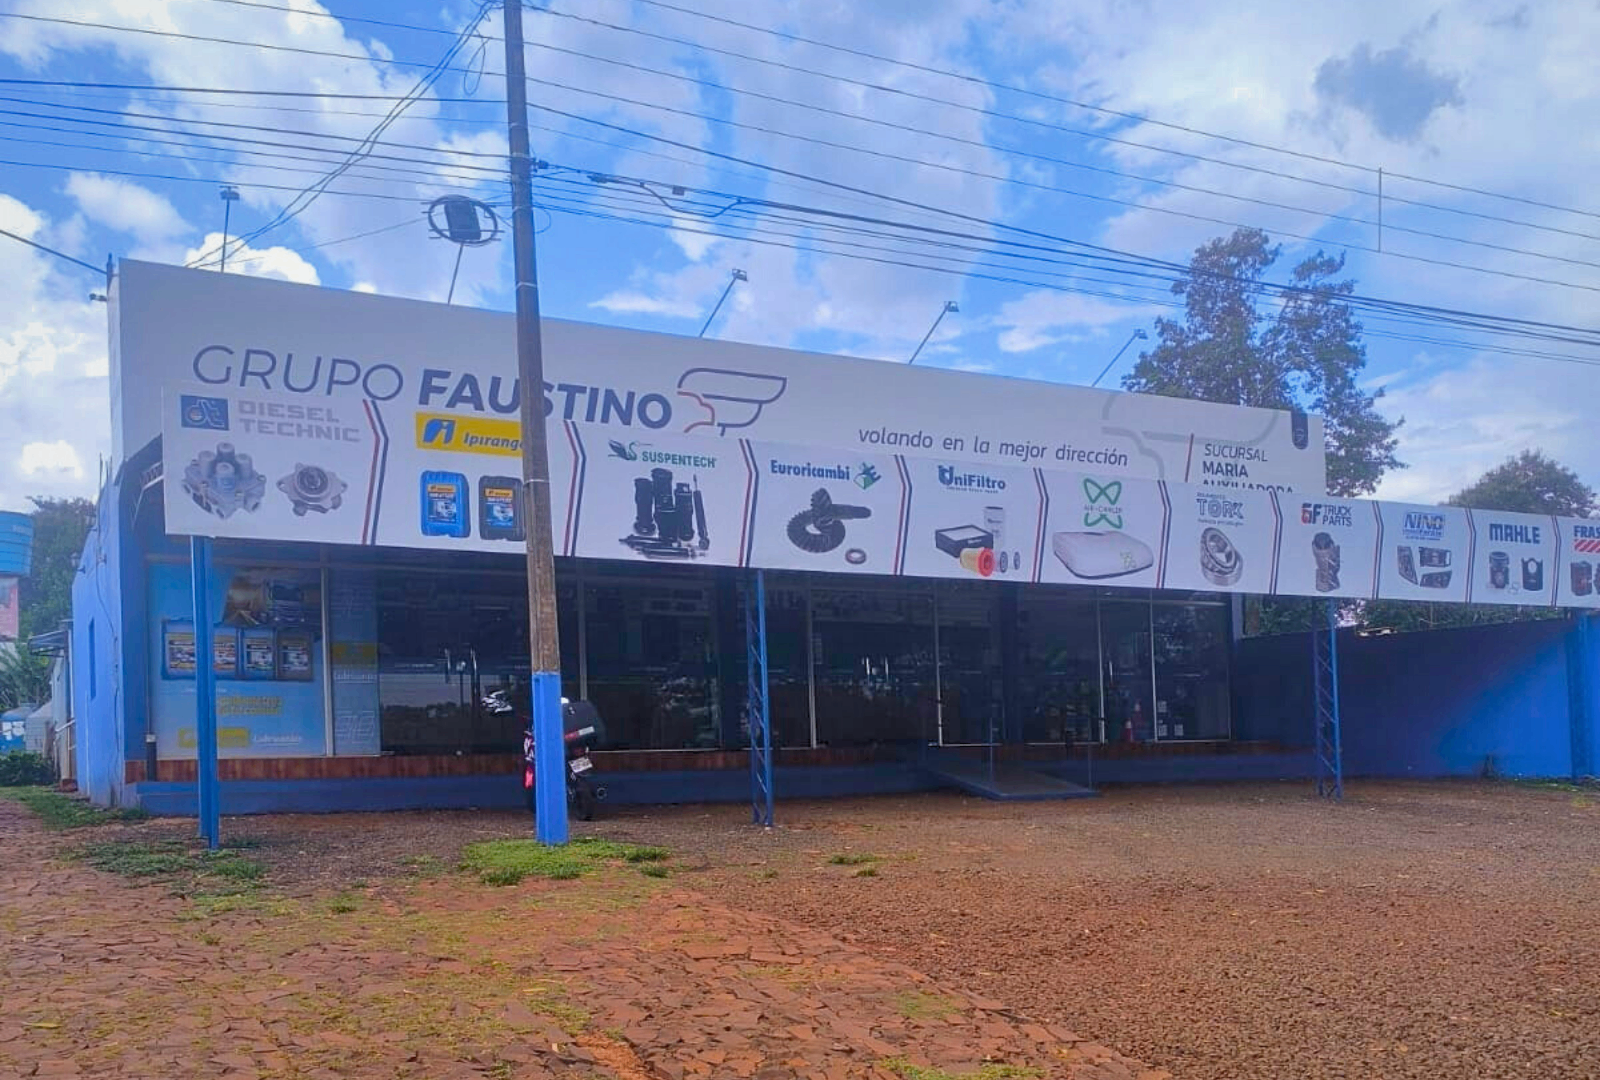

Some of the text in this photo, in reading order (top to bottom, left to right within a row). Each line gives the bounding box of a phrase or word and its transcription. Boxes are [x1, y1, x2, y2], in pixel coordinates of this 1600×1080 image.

[192, 344, 404, 401] GRUPO
[238, 400, 340, 423] DIESEL
[239, 418, 361, 443] TECHNIC
[463, 431, 524, 451] Ipirang
[859, 427, 1129, 467] volando en la mejor dirección
[1204, 443, 1268, 462] SUCURSAL
[642, 450, 716, 469] SUSPENTECH
[770, 459, 850, 481] Euroricambi
[1203, 461, 1249, 478] MARIA
[938, 465, 1006, 490] UniFiltro
[1196, 498, 1245, 519] TORK
[1323, 505, 1352, 516] TRUCK
[1322, 516, 1352, 527] PARTS
[1489, 523, 1541, 544] MAHLE
